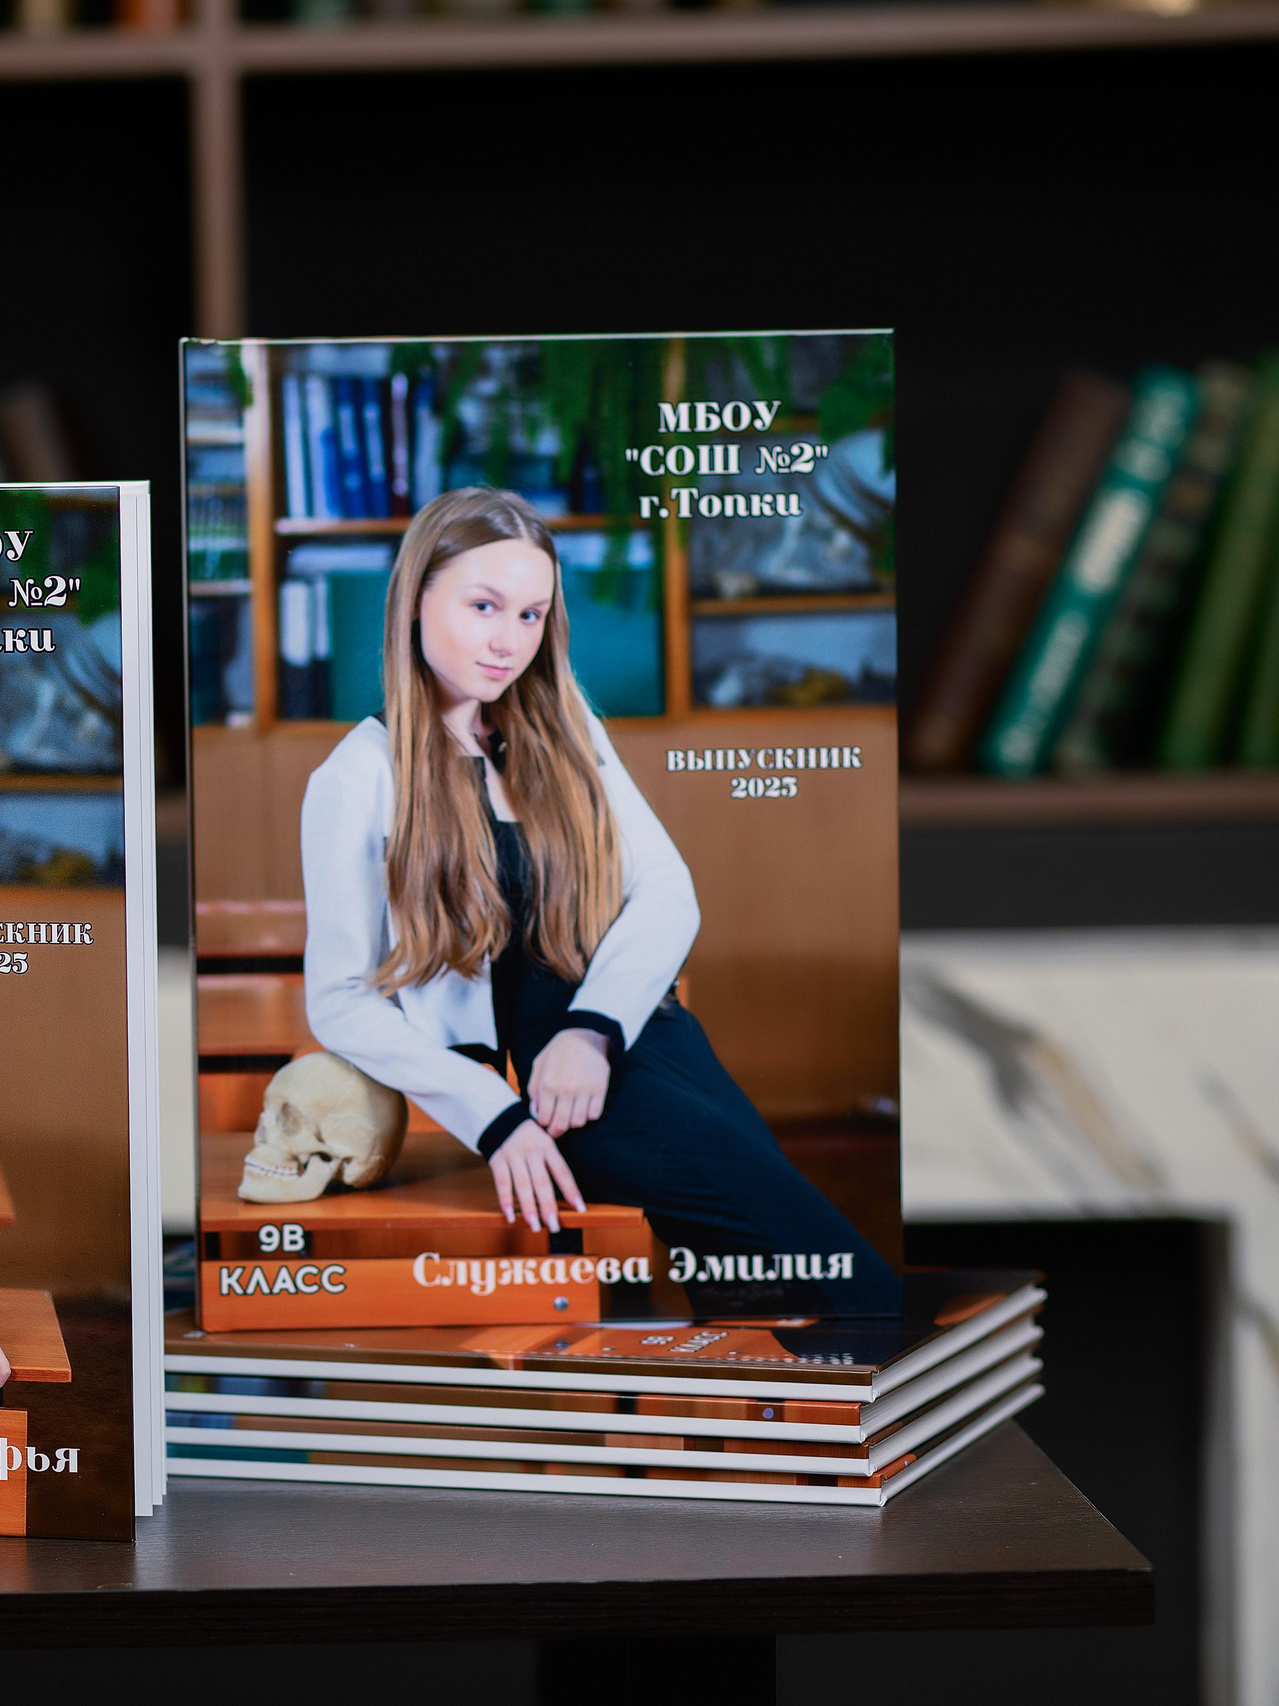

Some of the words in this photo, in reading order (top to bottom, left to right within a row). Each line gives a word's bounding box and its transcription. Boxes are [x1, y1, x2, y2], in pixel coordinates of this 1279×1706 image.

[659, 401, 780, 432] МБОУ
[626, 444, 740, 475] "СОШ
[755, 442, 828, 474] №2"
[640, 488, 801, 518] г.Топки
[8, 575, 80, 607] №2"
[667, 746, 861, 771] ВЫПУСКНИК
[730, 776, 798, 798] 2025
[259, 1224, 304, 1252] 9В
[221, 1265, 345, 1294] КЛАСС
[413, 1252, 651, 1296] Служаева
[669, 1248, 852, 1281] Эмилия
